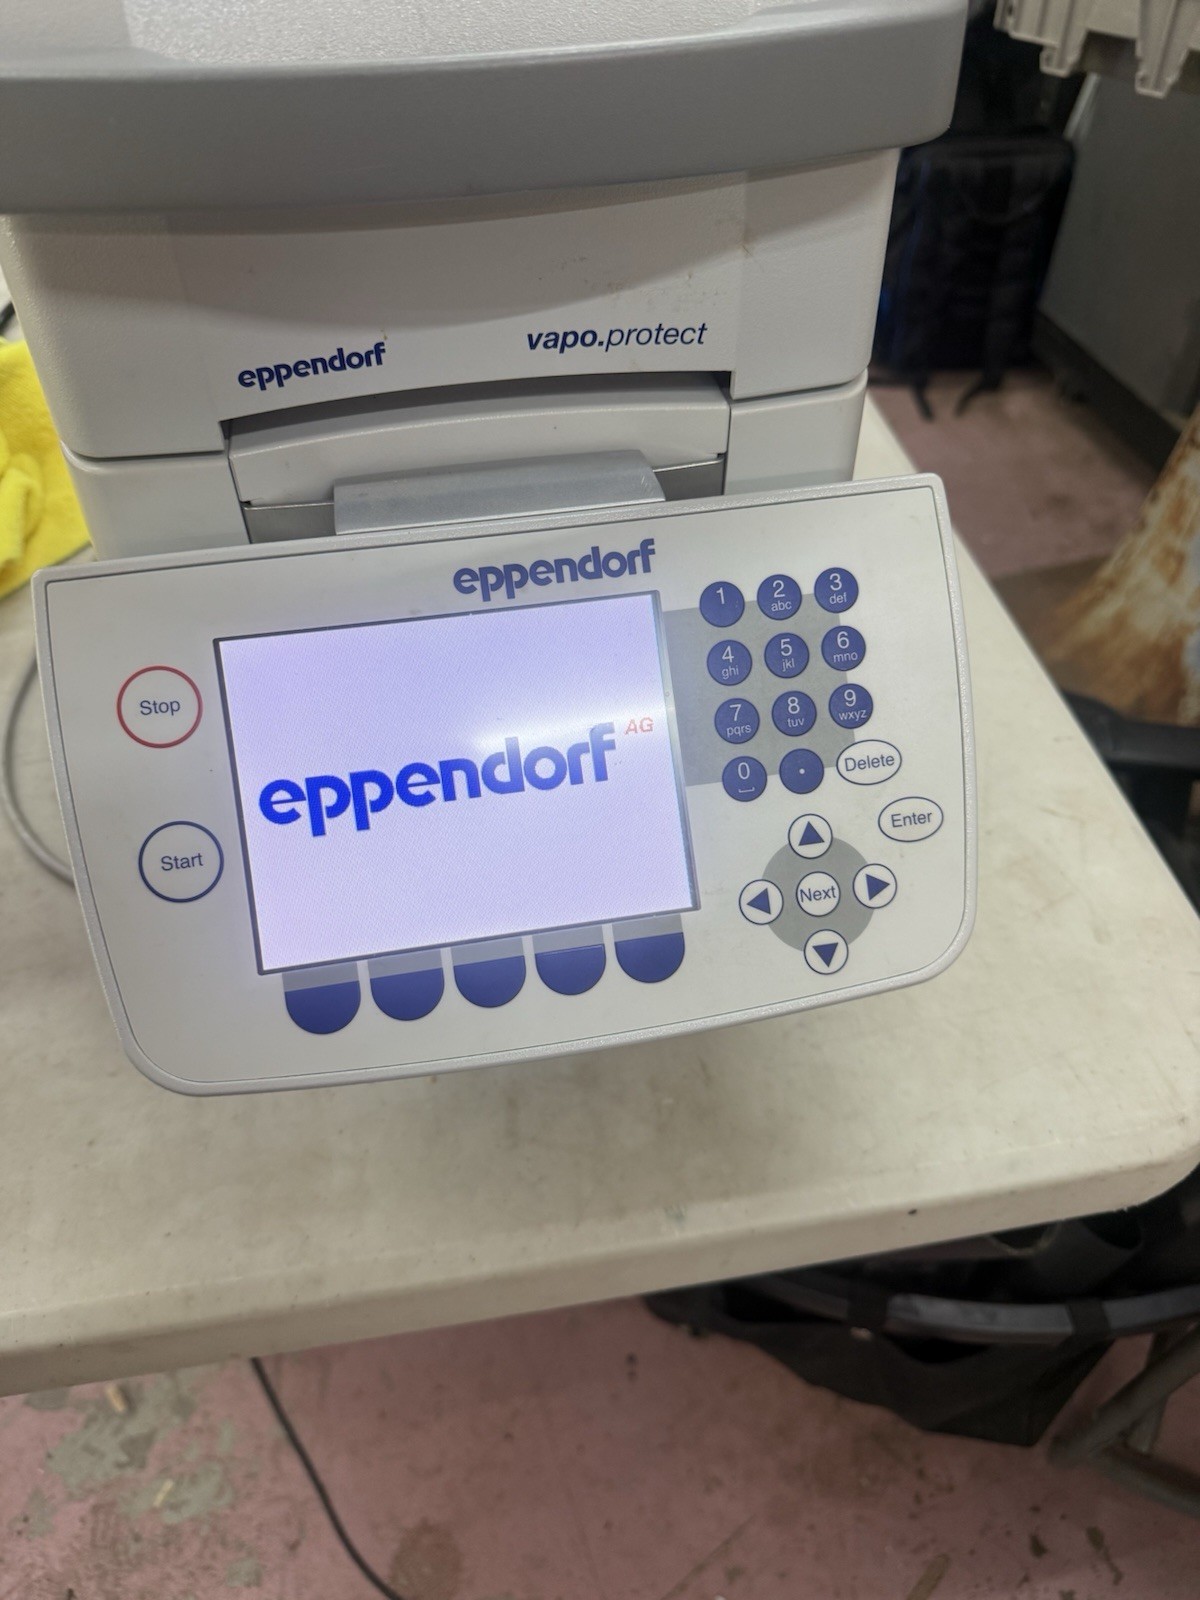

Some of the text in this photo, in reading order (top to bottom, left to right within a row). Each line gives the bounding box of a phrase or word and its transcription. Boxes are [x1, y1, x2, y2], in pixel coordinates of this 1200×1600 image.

[526, 321, 708, 354] vapo.protect
[237, 342, 387, 391] eppendorf
[452, 538, 656, 602] eppendorf
[772, 580, 785, 598] 2
[829, 573, 843, 591] 3
[716, 587, 726, 605] 1
[829, 592, 848, 605] def
[771, 600, 792, 612] abc
[780, 638, 793, 656] 5
[836, 631, 850, 649] 6
[721, 646, 735, 663] 4
[833, 651, 858, 663] mno
[721, 665, 739, 680] ghi
[781, 658, 795, 672] jkl
[787, 696, 800, 714] 8
[843, 689, 857, 707] 9
[138, 697, 181, 718] Stop
[729, 704, 742, 722] 7
[838, 708, 868, 722] wxyz
[726, 722, 752, 738] pqrs
[787, 716, 805, 728] tuv
[737, 762, 751, 780] 0
[844, 754, 896, 772] Delete
[258, 716, 655, 837] eppendorf AG
[891, 811, 933, 828] Enter
[160, 851, 204, 873] Start
[800, 885, 837, 903] Next
